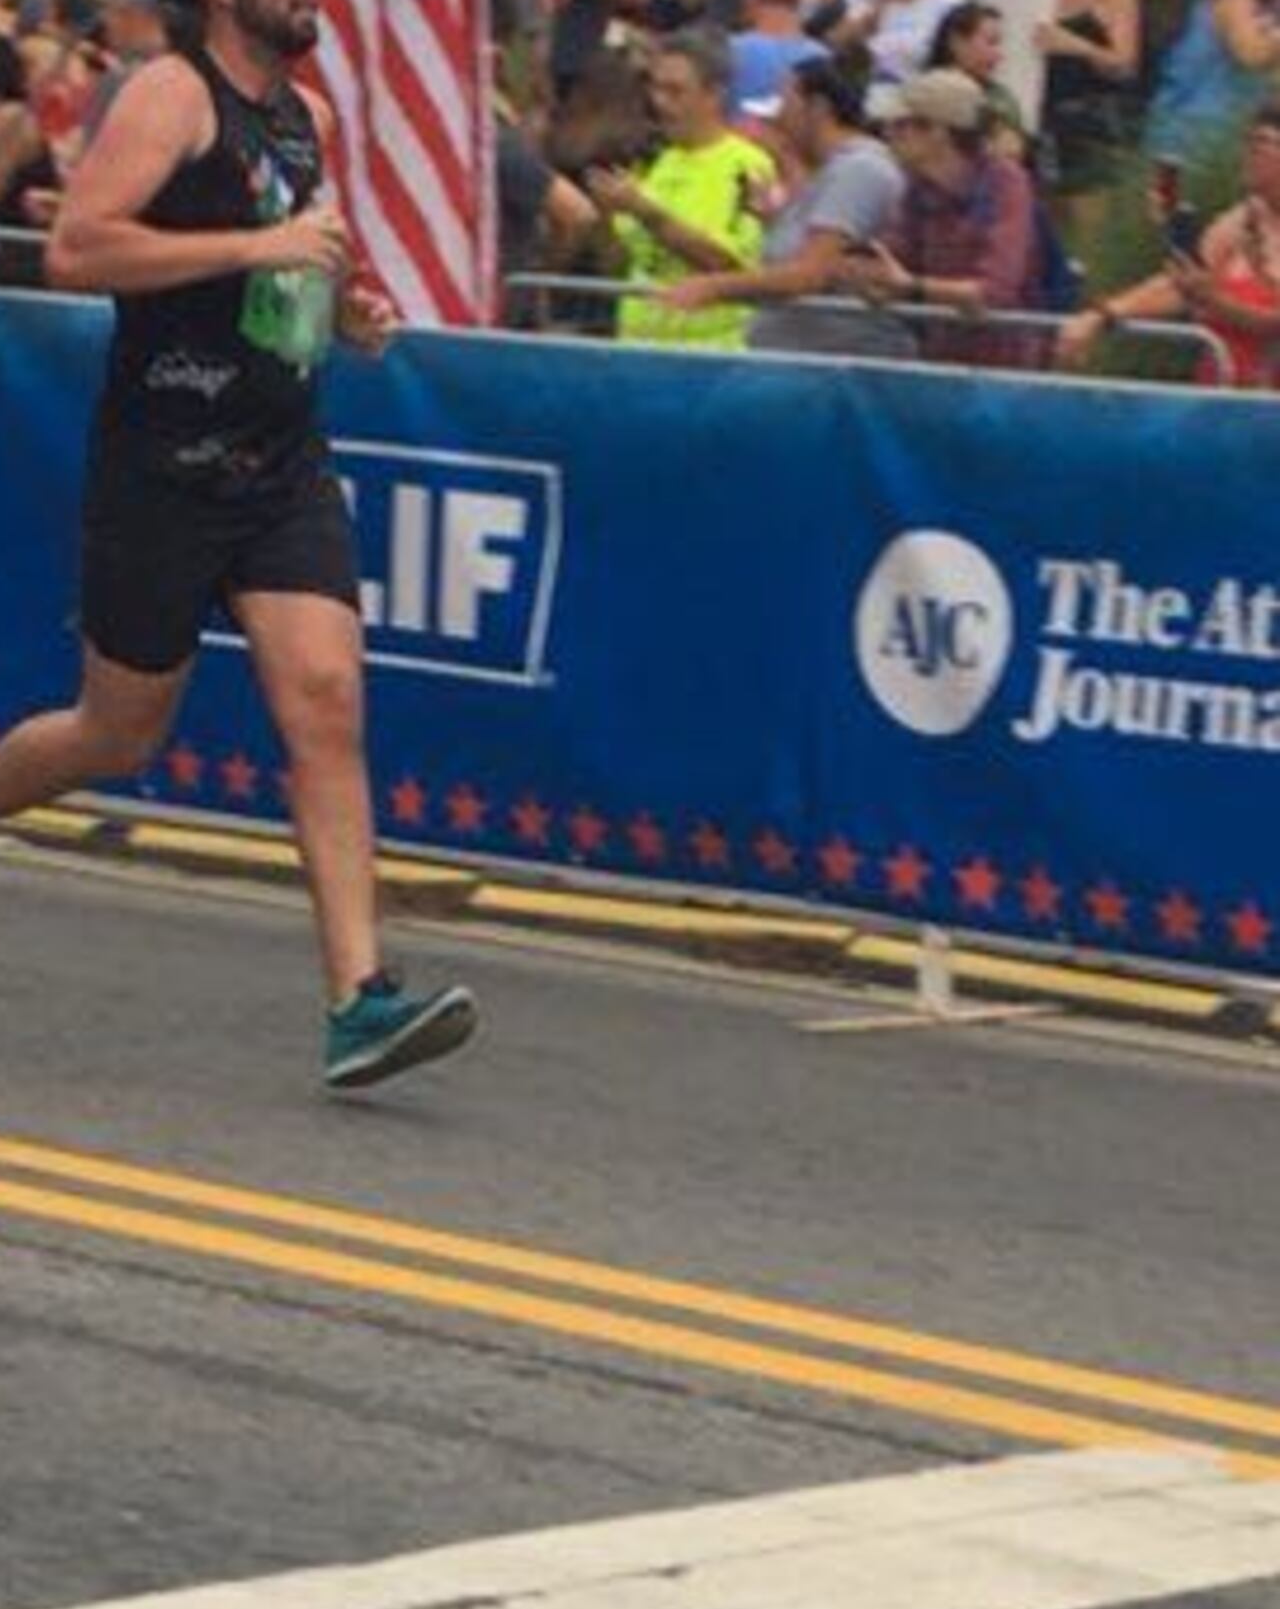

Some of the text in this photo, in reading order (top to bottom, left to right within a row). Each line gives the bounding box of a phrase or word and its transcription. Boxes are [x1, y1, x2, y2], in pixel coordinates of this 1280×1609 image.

[338, 475, 530, 640] IF
[1036, 557, 1192, 648] The
[876, 590, 988, 677] AJC
